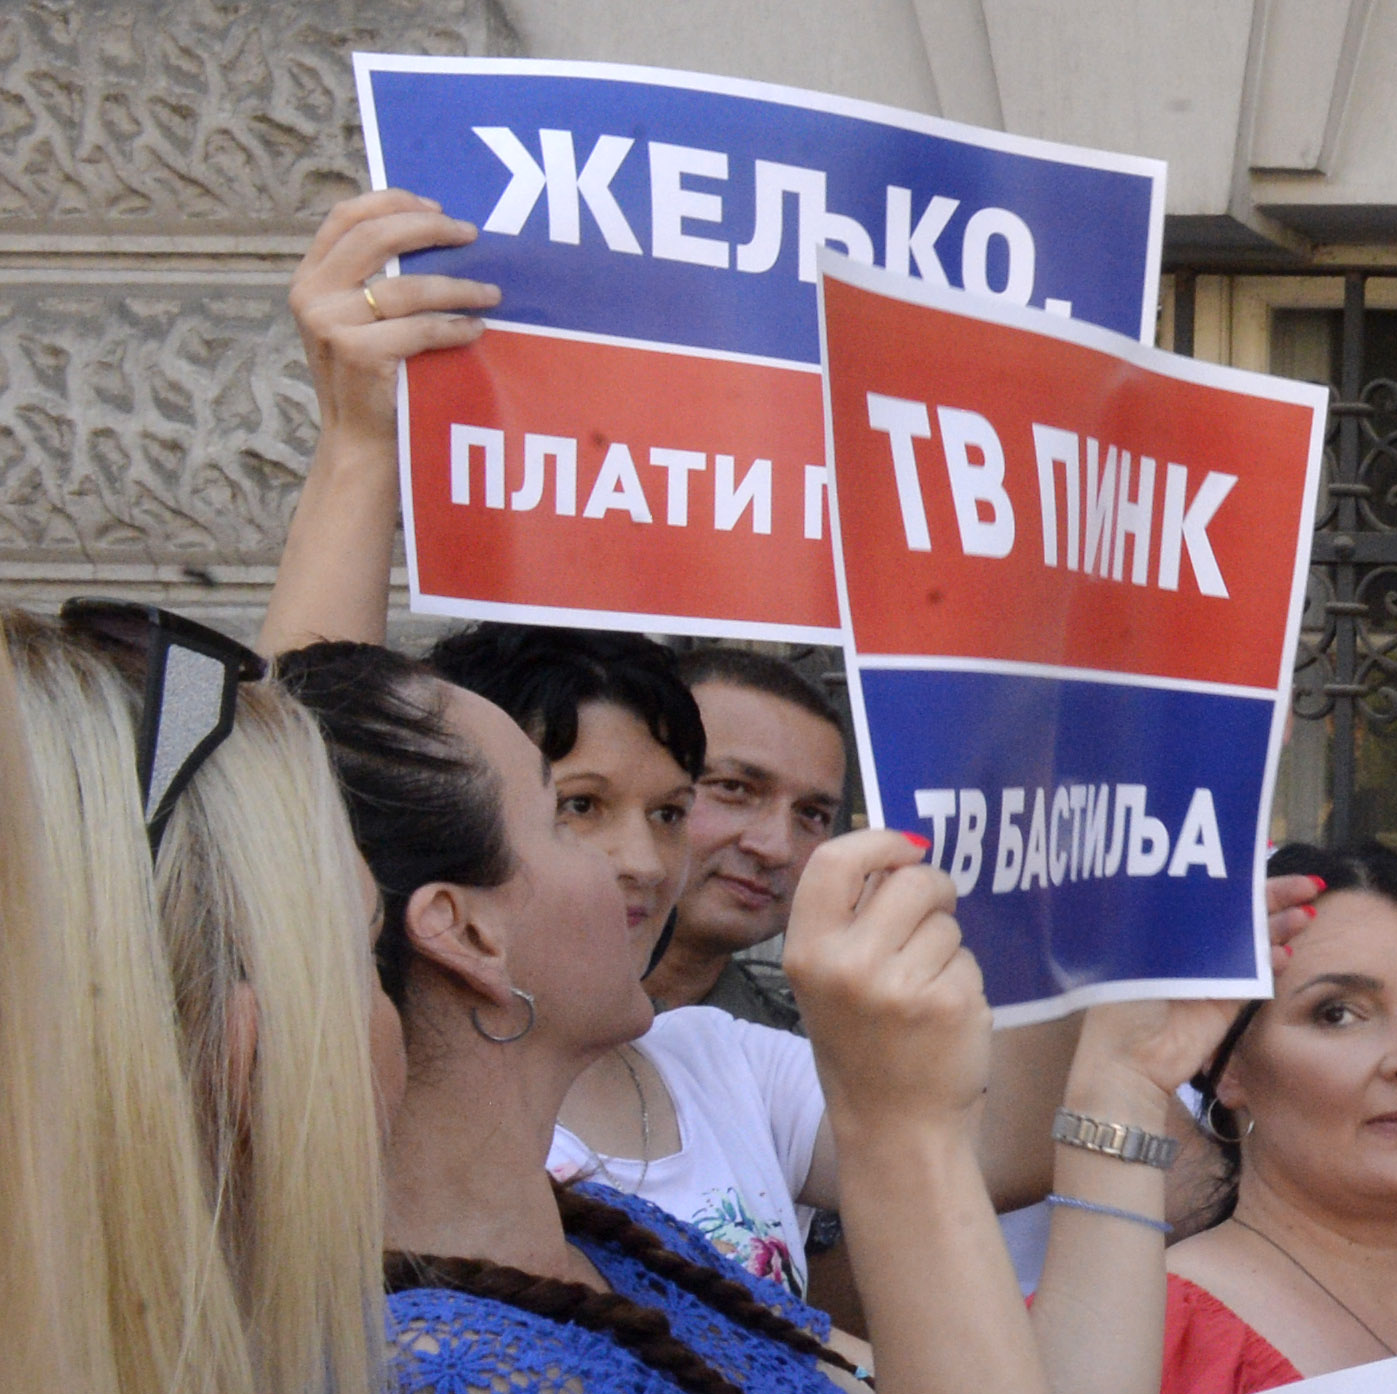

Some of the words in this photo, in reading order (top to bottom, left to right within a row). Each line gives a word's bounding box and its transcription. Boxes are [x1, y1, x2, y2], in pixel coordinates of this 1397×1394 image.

[450, 422, 772, 535] ПЛАТИ
[866, 391, 1016, 559] ТВ
[1031, 421, 1239, 599] ПИНК
[914, 787, 987, 898] ТВ
[992, 783, 1228, 894] БАСТИЉА
